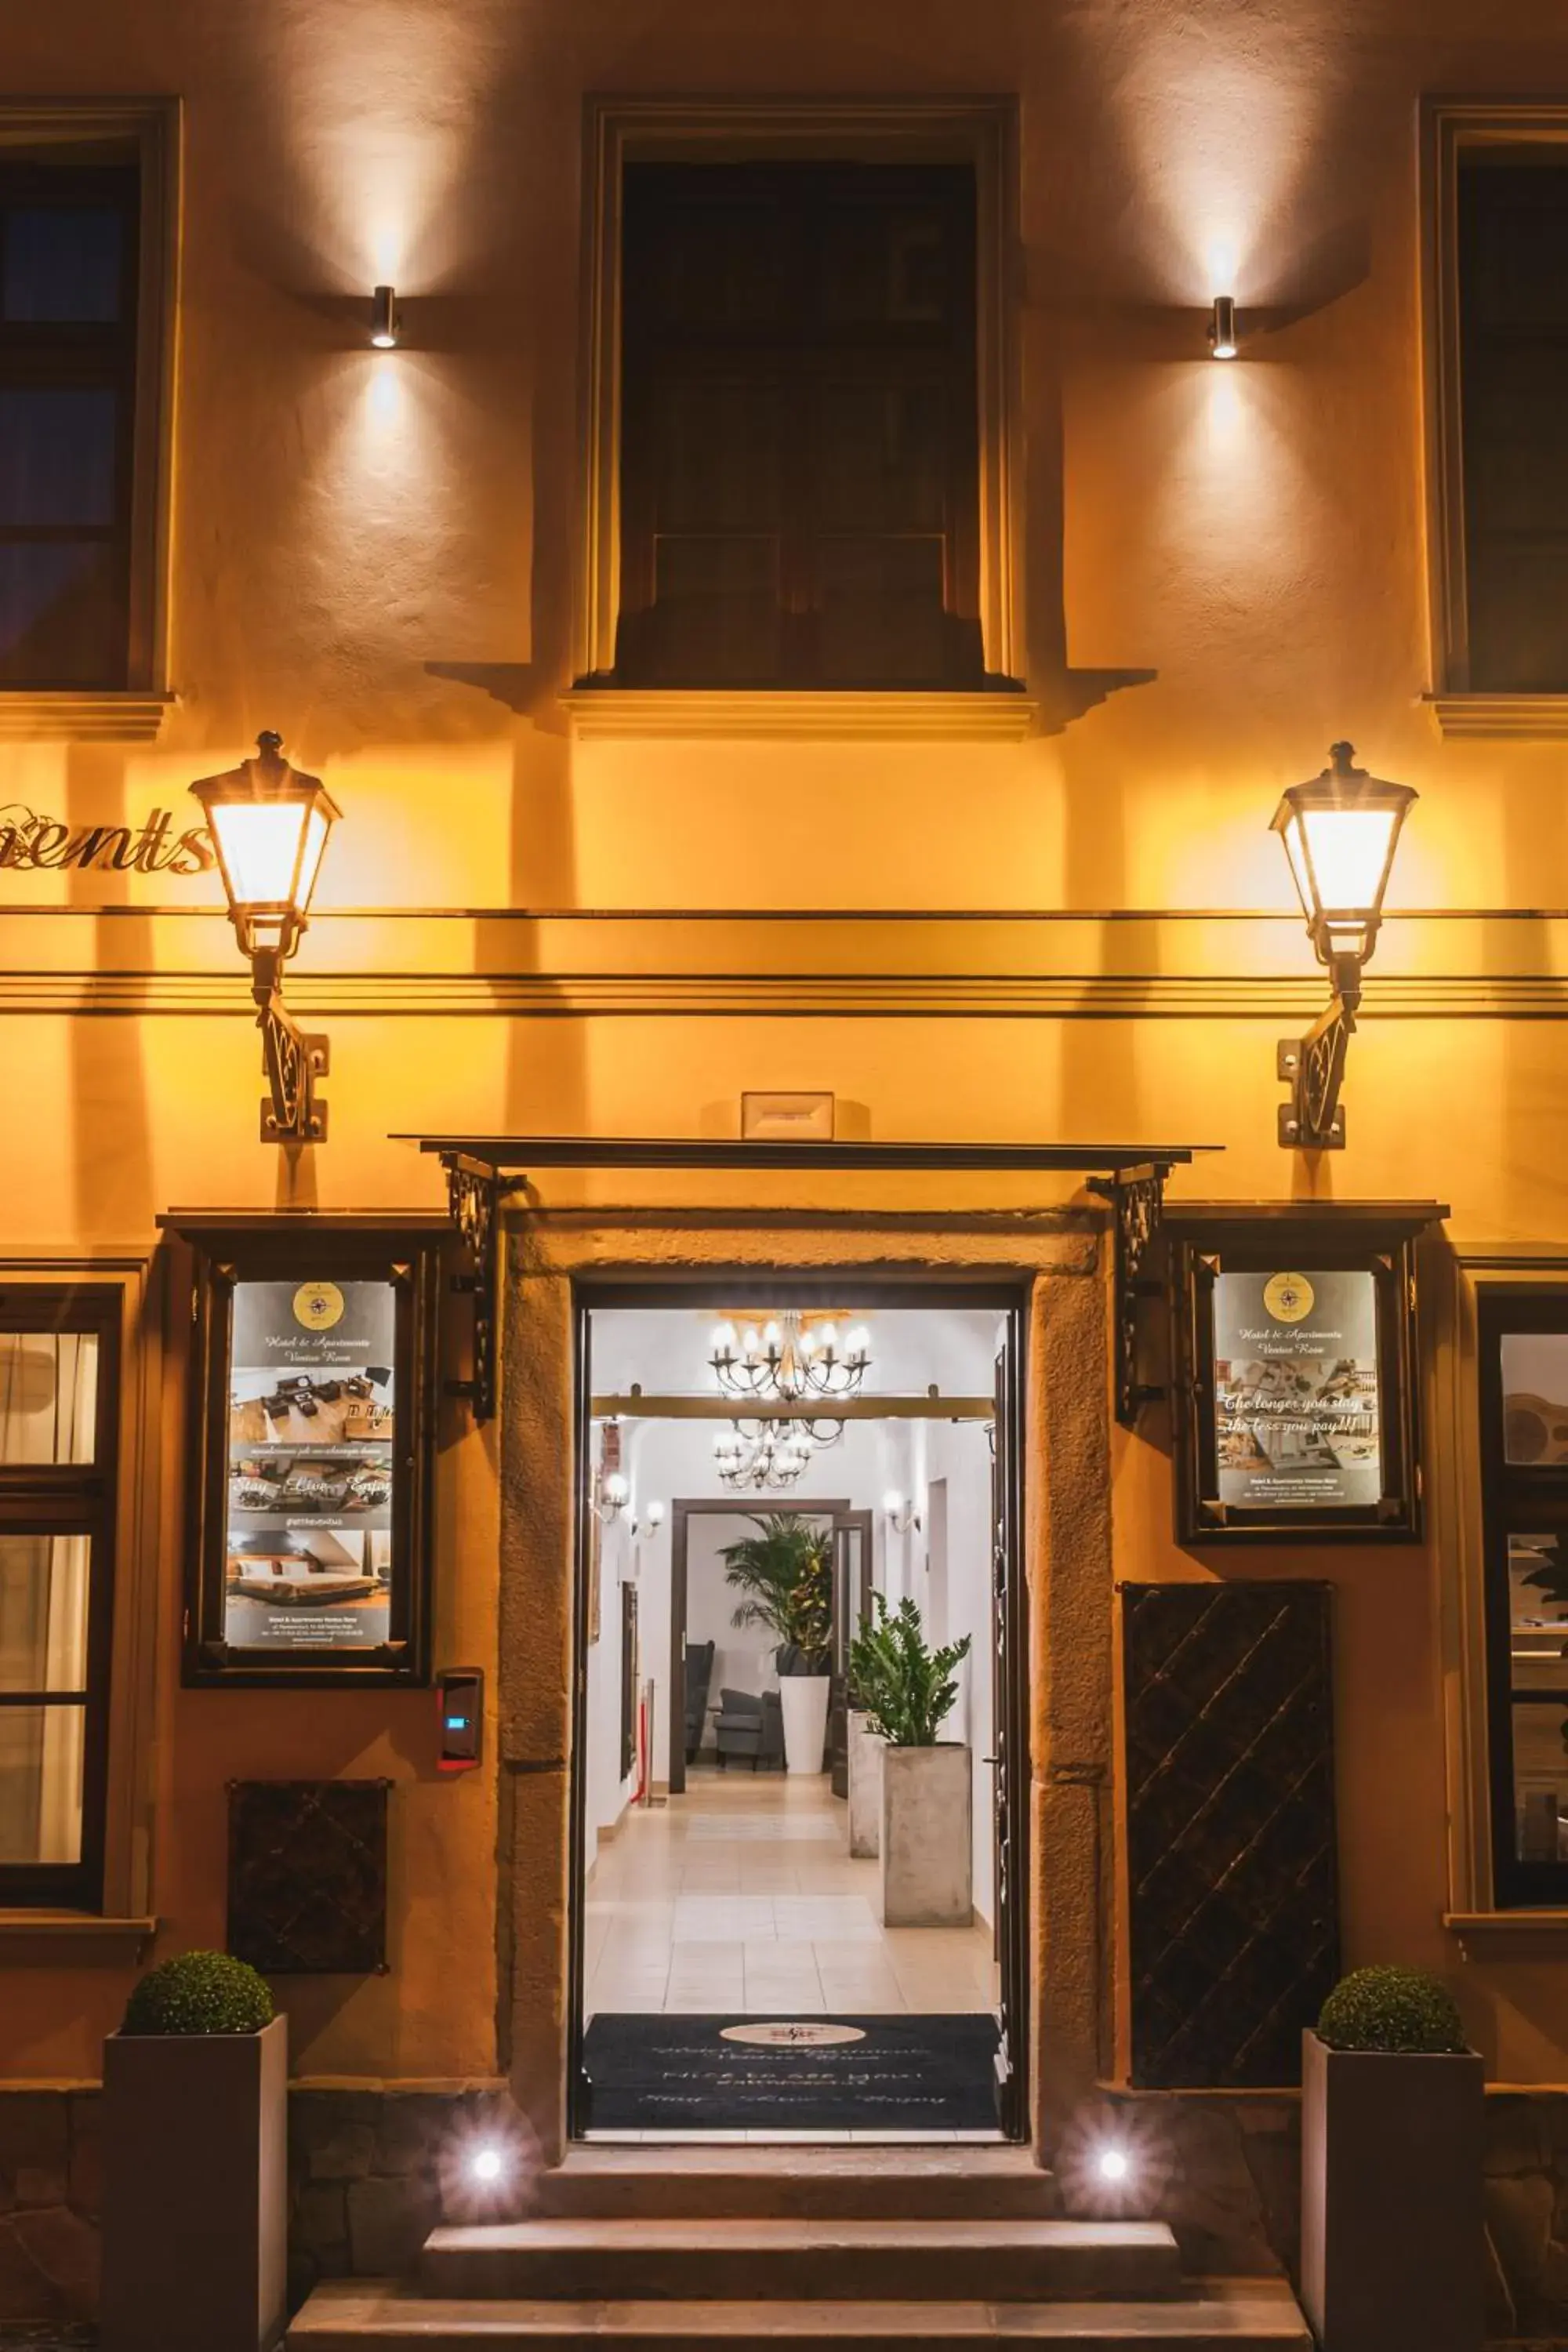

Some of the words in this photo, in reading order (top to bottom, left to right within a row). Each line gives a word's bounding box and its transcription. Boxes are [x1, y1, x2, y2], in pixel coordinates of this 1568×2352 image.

[0, 808, 216, 874] ents
[1225, 1393, 1252, 1410] The
[1255, 1393, 1299, 1413] longer
[1301, 1398, 1329, 1413] you
[1229, 1417, 1250, 1432] the
[1253, 1417, 1281, 1432] less
[1284, 1423, 1307, 1435] you
[1312, 1415, 1357, 1436] pay!!!
